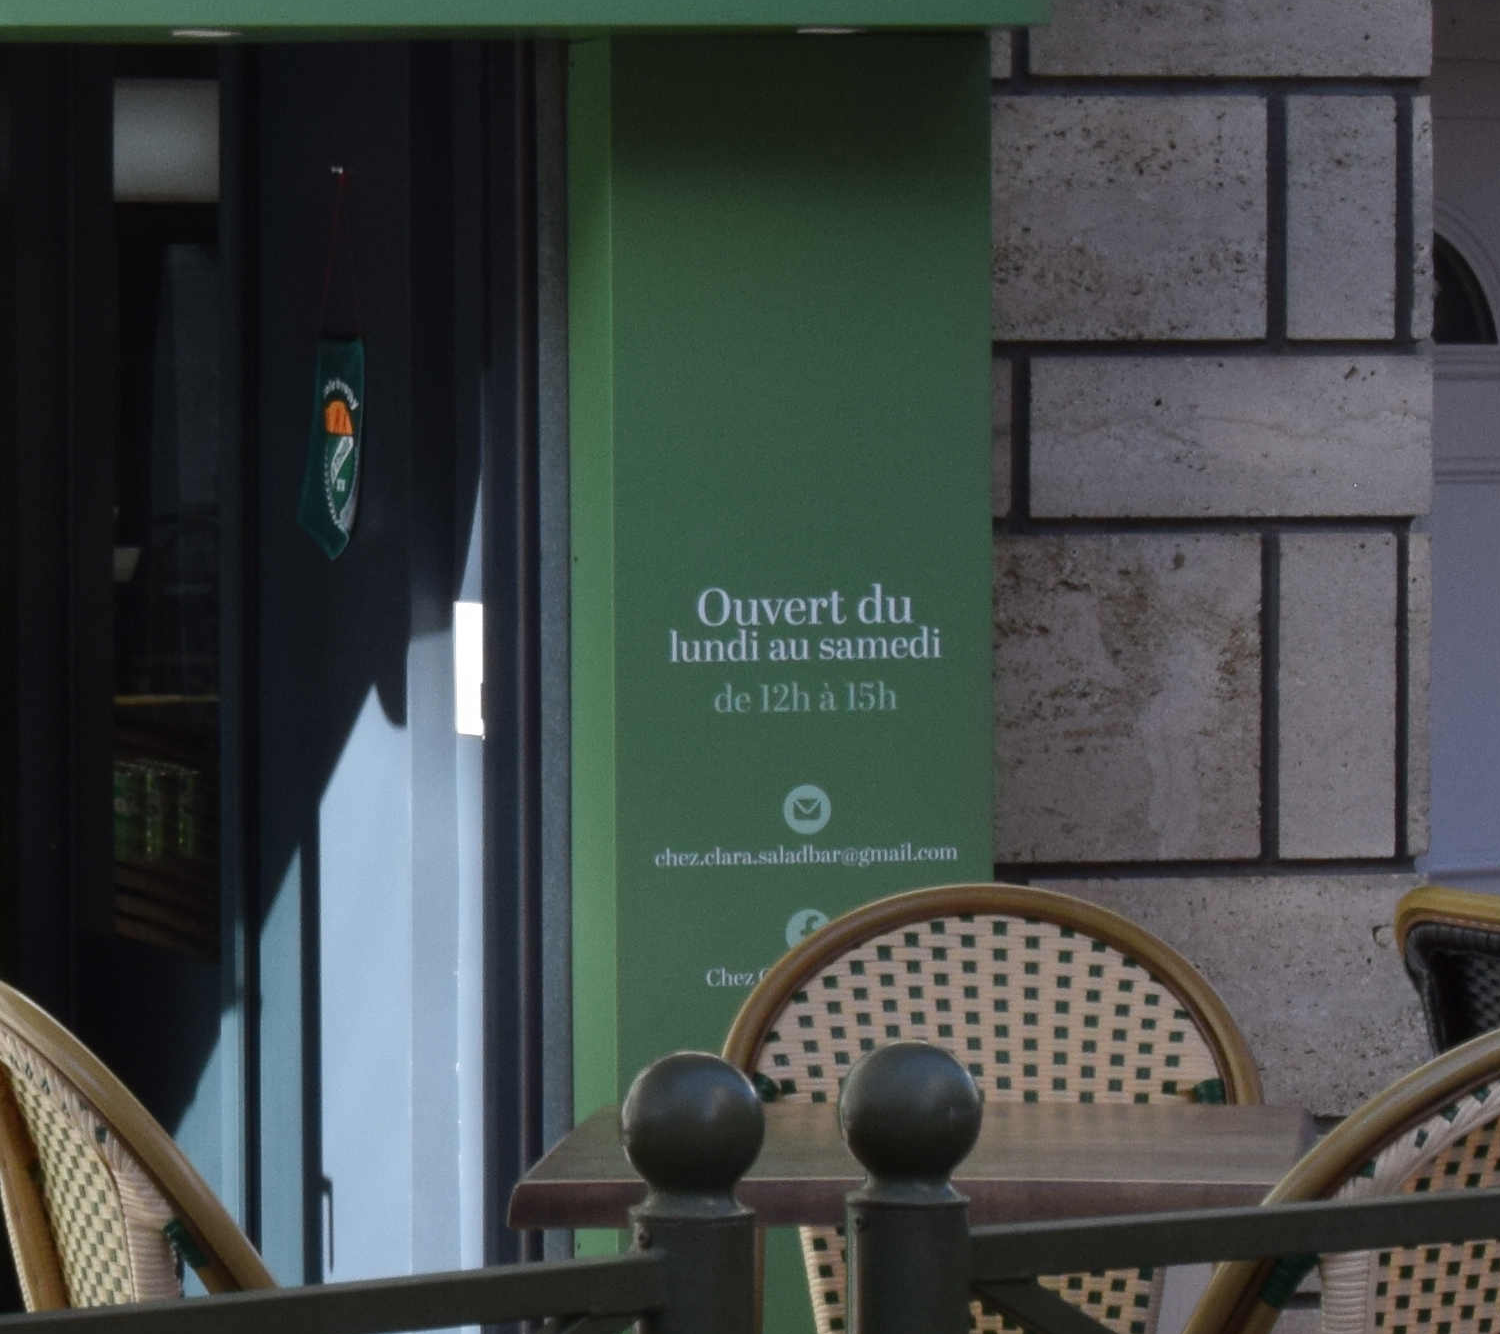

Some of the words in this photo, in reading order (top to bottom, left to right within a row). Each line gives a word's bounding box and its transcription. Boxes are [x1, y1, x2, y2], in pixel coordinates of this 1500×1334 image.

[697, 587, 847, 627] Ouvert
[857, 583, 915, 625] du
[669, 628, 761, 663] lundi
[769, 637, 810, 661] au
[818, 626, 943, 661] samedi
[713, 683, 751, 714] de
[759, 682, 811, 714] 12h
[819, 683, 837, 712] à
[846, 680, 897, 711] 15h
[654, 844, 958, 868] chez.clara.saladbar@gmail.com
[705, 968, 755, 988] Chez
